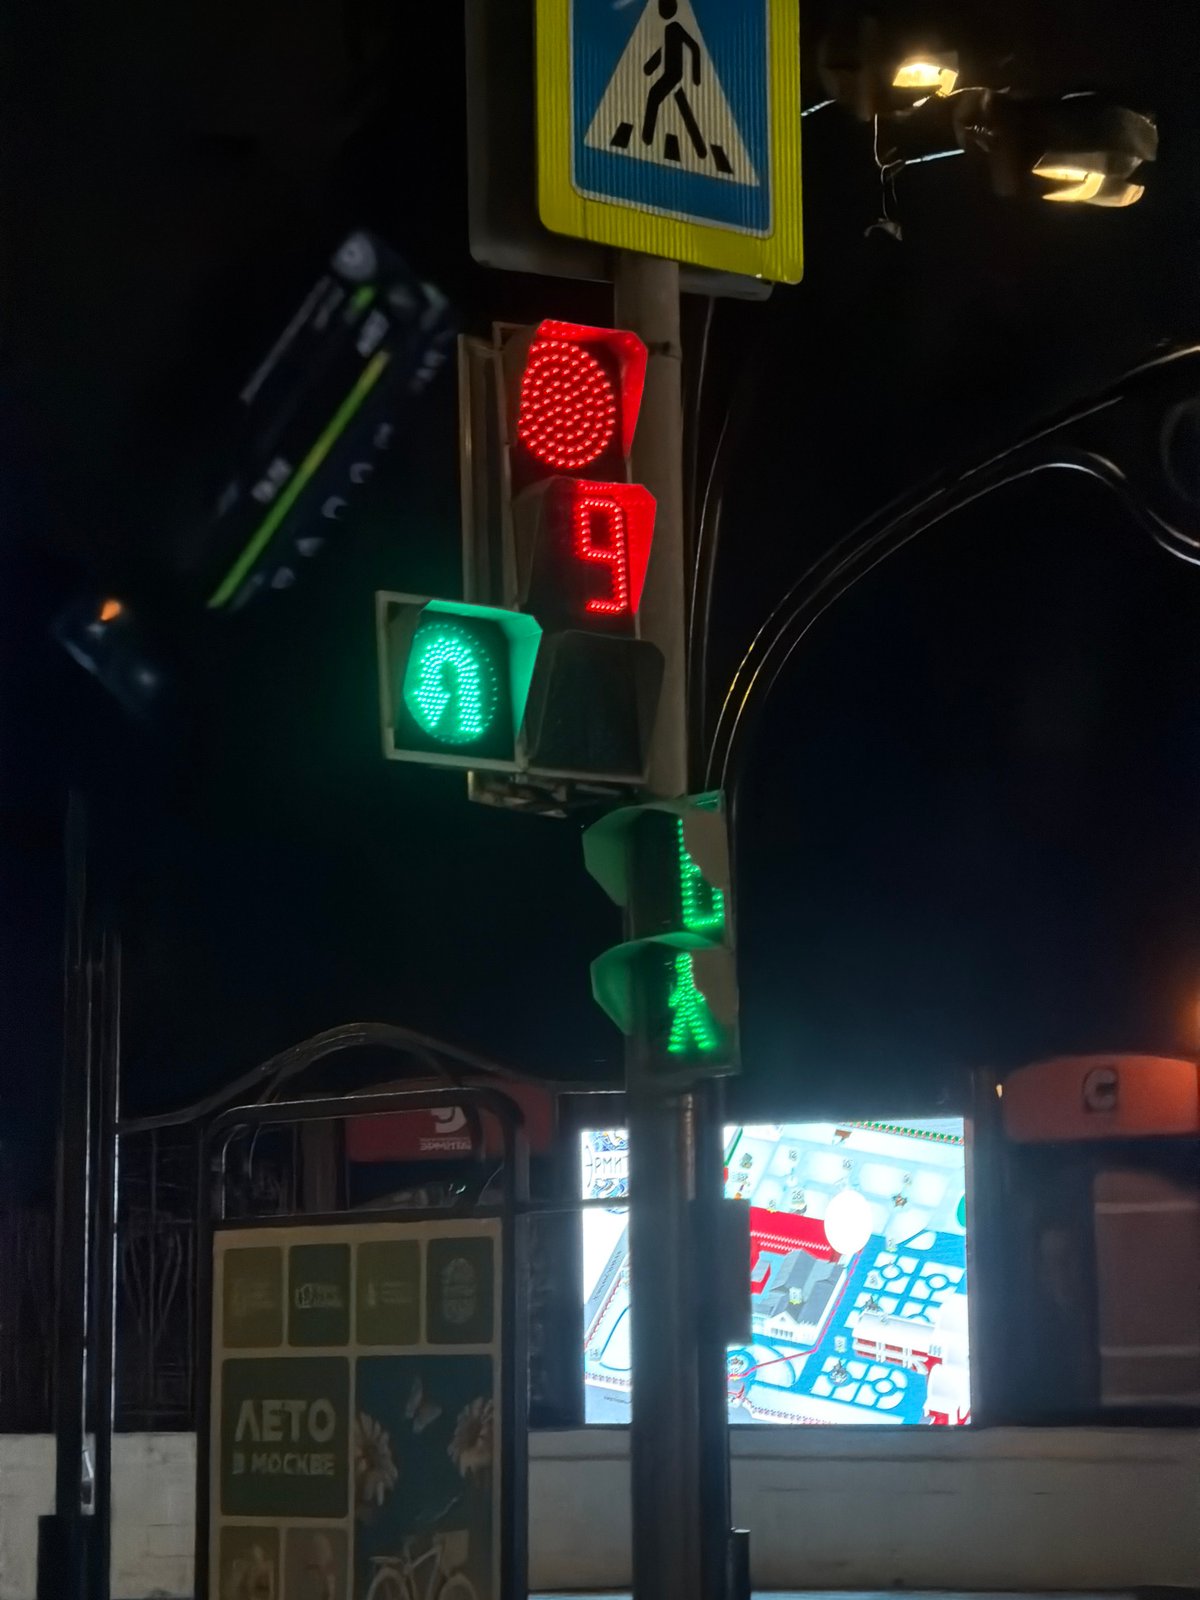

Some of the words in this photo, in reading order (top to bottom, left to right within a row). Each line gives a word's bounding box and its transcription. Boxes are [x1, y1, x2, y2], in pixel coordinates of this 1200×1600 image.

[575, 498, 628, 614] 9
[234, 1398, 337, 1443] ЛЕТО
[250, 1452, 336, 1476] МОСКВЕ
